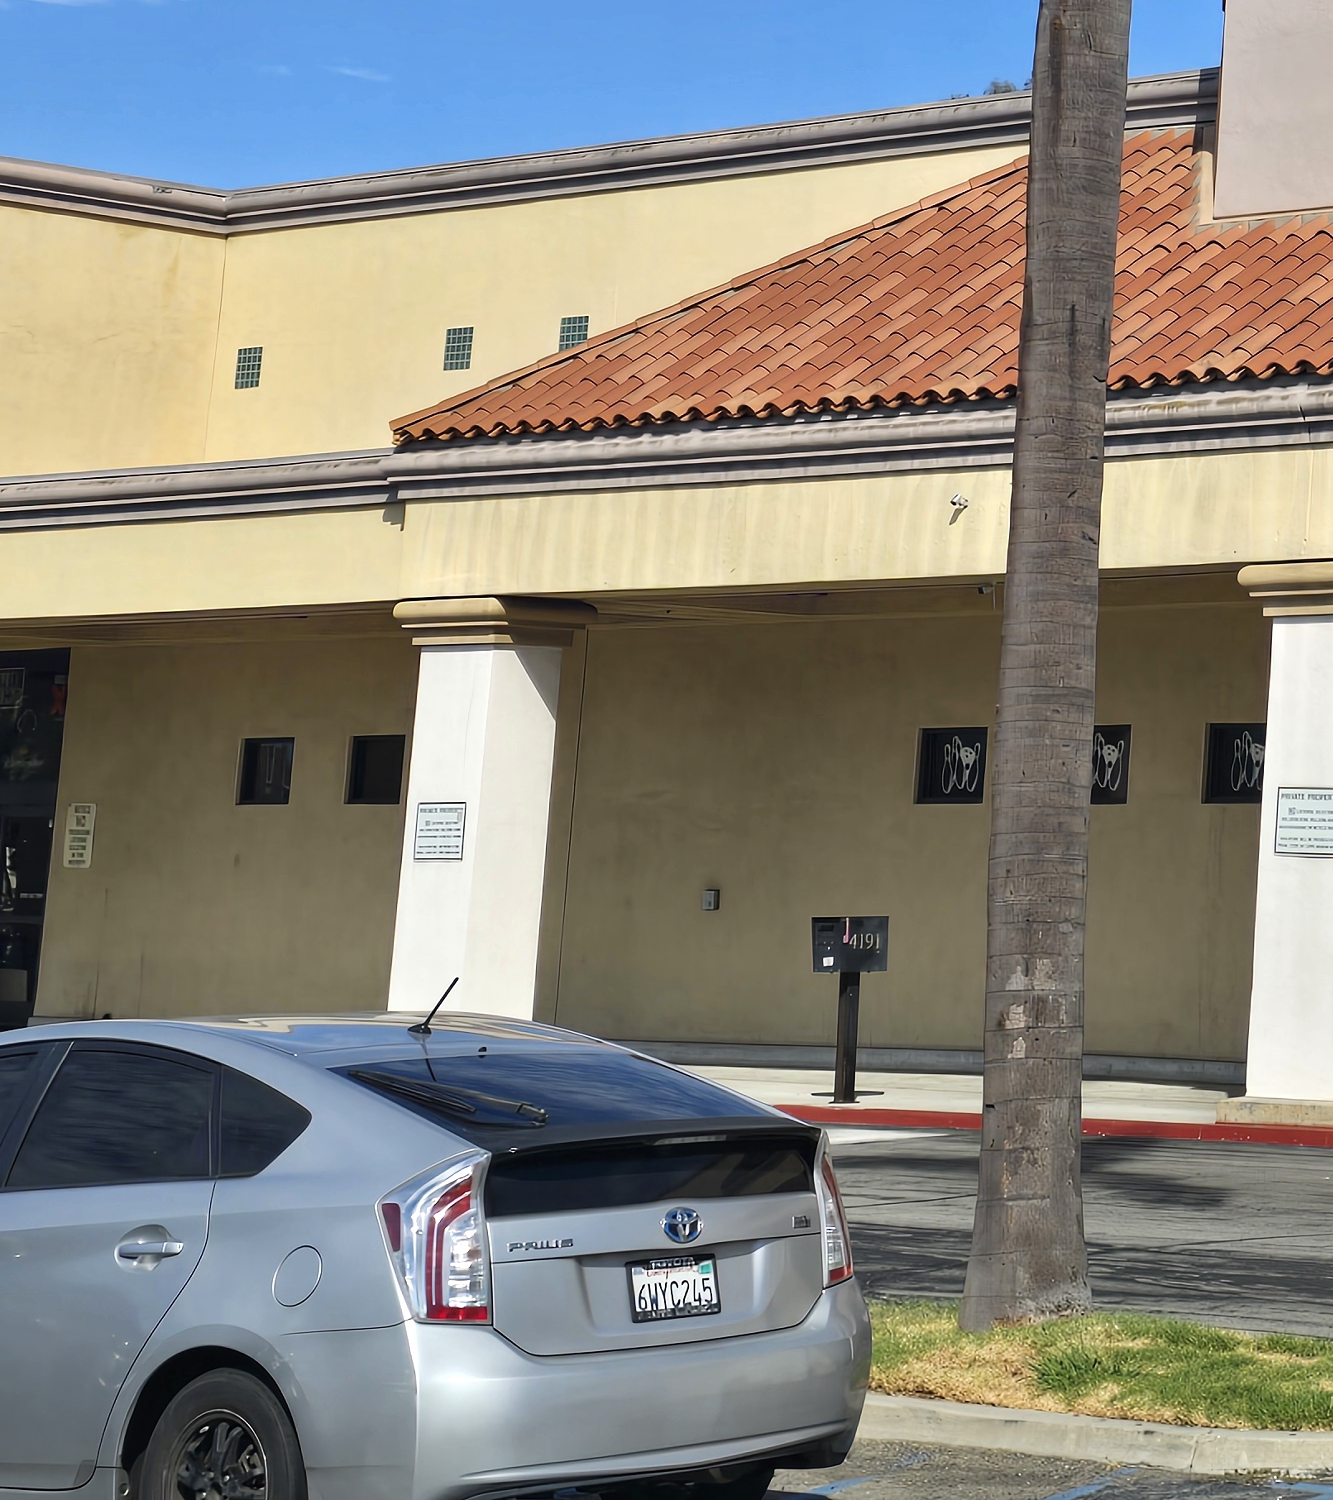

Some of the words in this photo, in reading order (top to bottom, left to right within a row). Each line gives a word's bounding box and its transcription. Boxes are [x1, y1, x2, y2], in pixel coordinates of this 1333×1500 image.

[849, 932, 881, 950] 4191
[506, 1238, 574, 1253] PRIUS
[638, 1277, 713, 1312] 6WYC245
